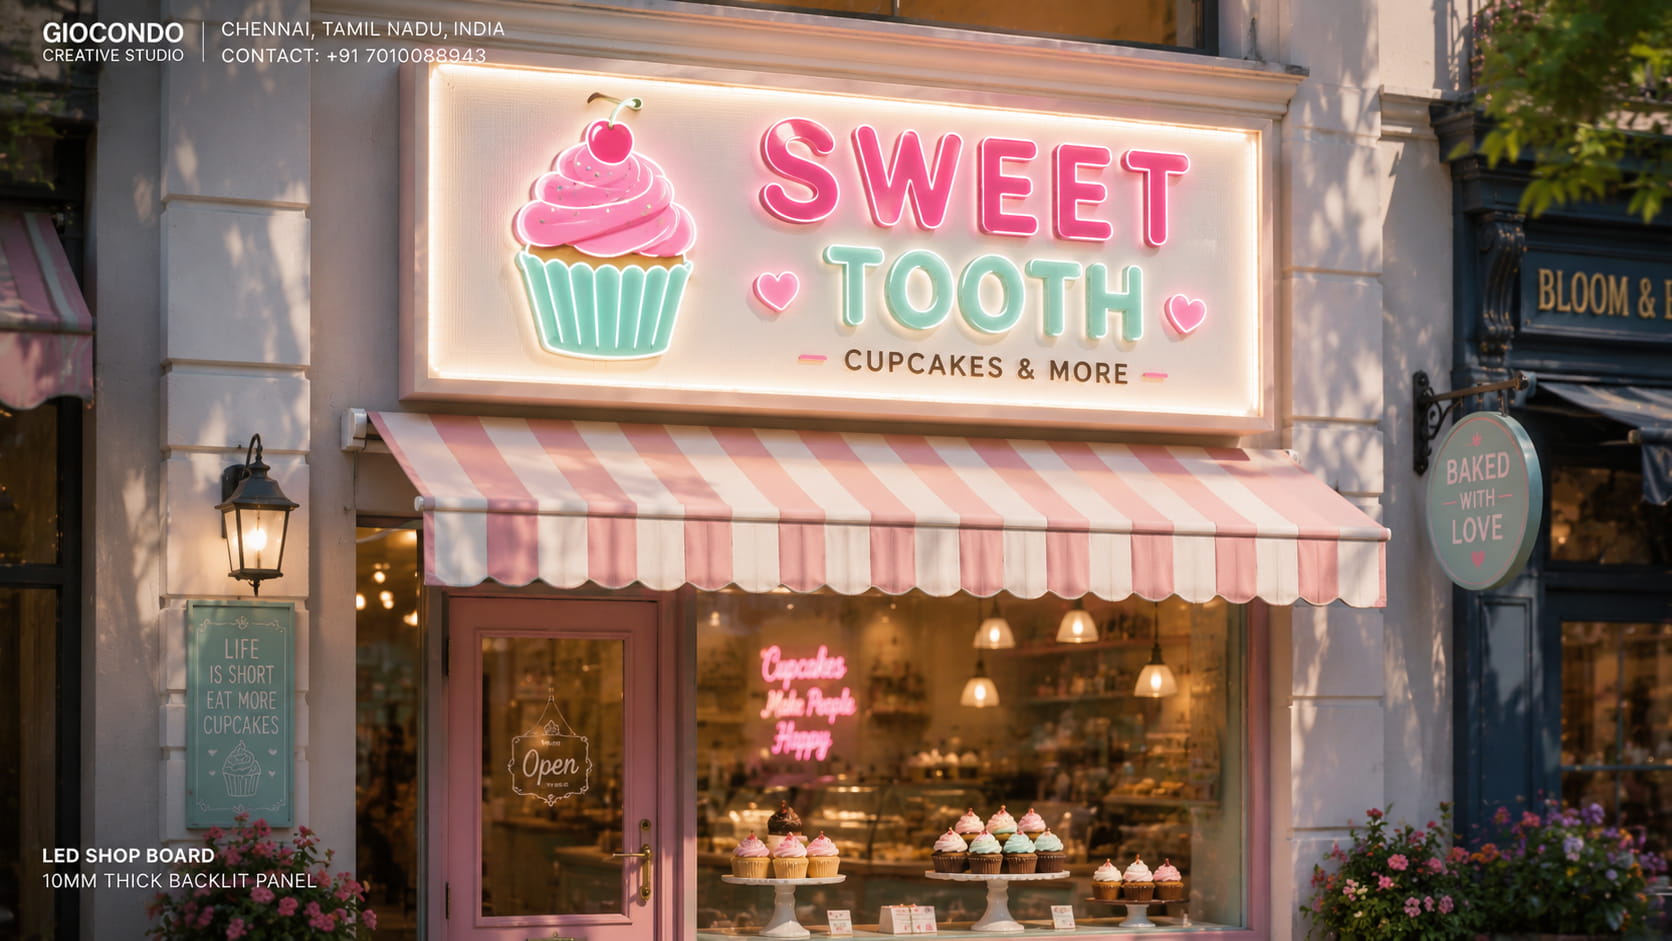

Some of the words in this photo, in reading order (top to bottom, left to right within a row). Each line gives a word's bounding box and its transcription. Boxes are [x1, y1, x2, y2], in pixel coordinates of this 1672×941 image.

[758, 117, 1191, 247] SWEET
[822, 244, 1144, 341] TOOTH
[1538, 268, 1629, 316] BLOOM
[1637, 277, 1656, 319] &
[844, 348, 1003, 379] CUPCAKES
[1017, 358, 1035, 380] &
[1049, 359, 1129, 385] MORE
[1446, 451, 1510, 485] BAKED
[1459, 488, 1495, 510] WITH
[1452, 514, 1503, 545] LOVE
[224, 638, 260, 660] LIFE
[209, 665, 222, 684] IS
[228, 665, 274, 684] SHORT
[761, 645, 848, 691] Cupcakes
[207, 691, 232, 709] EAT
[238, 691, 277, 710] MORE
[203, 715, 279, 735] CUPCAKES
[771, 720, 833, 761] Happy
[522, 748, 579, 786] Open
